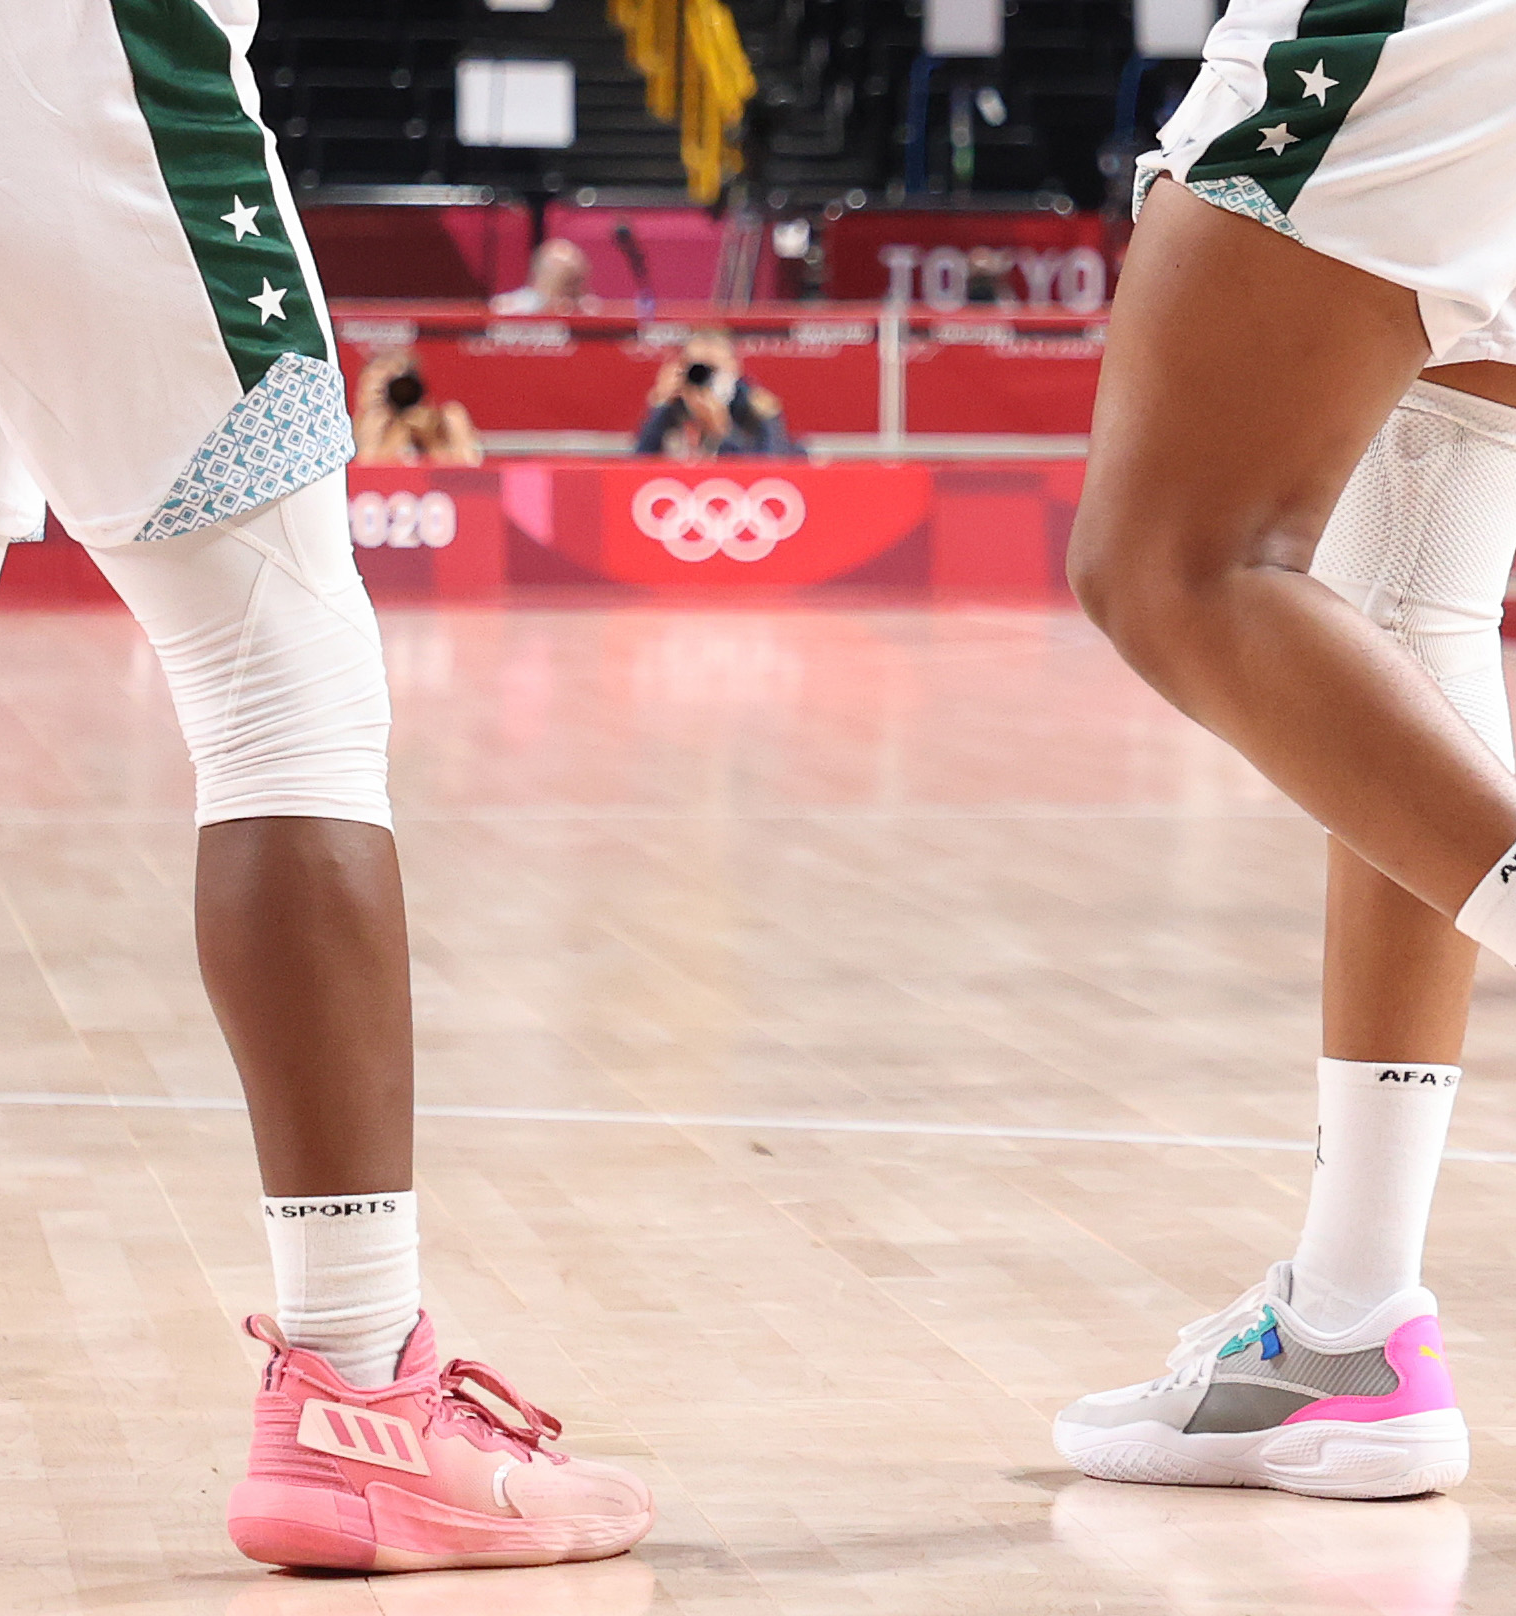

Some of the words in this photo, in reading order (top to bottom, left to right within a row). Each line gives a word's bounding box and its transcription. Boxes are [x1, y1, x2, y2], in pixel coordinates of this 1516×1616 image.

[879, 244, 1107, 312] TOYO
[348, 490, 458, 549] 020
[1378, 1069, 1437, 1086] AFA
[281, 1199, 396, 1218] SPORTS
